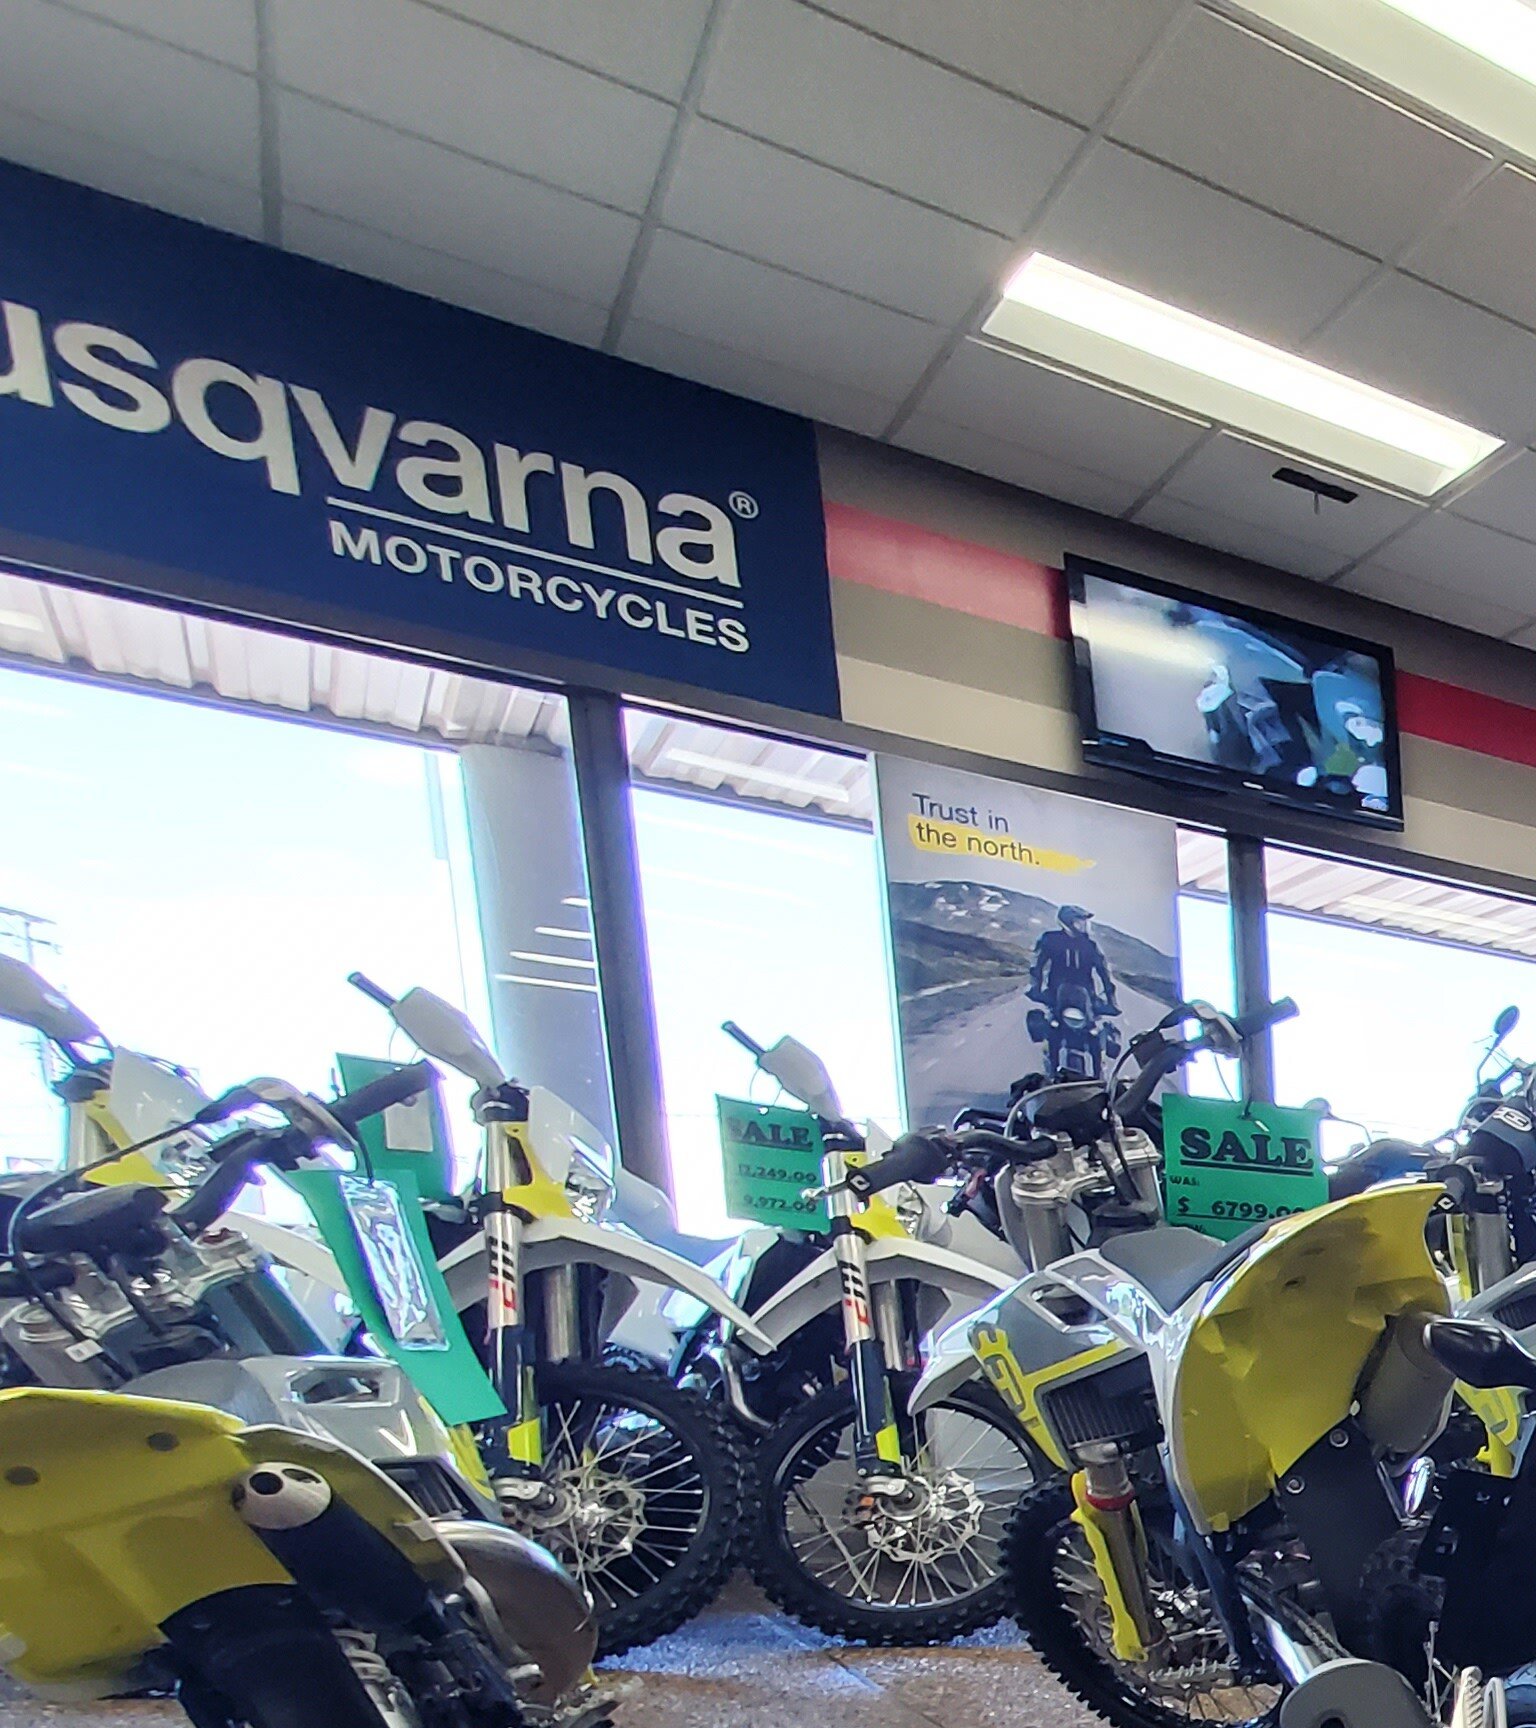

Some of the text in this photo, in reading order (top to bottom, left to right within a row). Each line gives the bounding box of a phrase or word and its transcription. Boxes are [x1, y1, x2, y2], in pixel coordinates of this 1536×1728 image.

[0, 300, 758, 588] usqvarna®
[329, 520, 750, 652] MOTORCYCLES
[912, 793, 1009, 833] Trust in
[916, 822, 1040, 865] the north.
[1180, 1126, 1314, 1169] SALE
